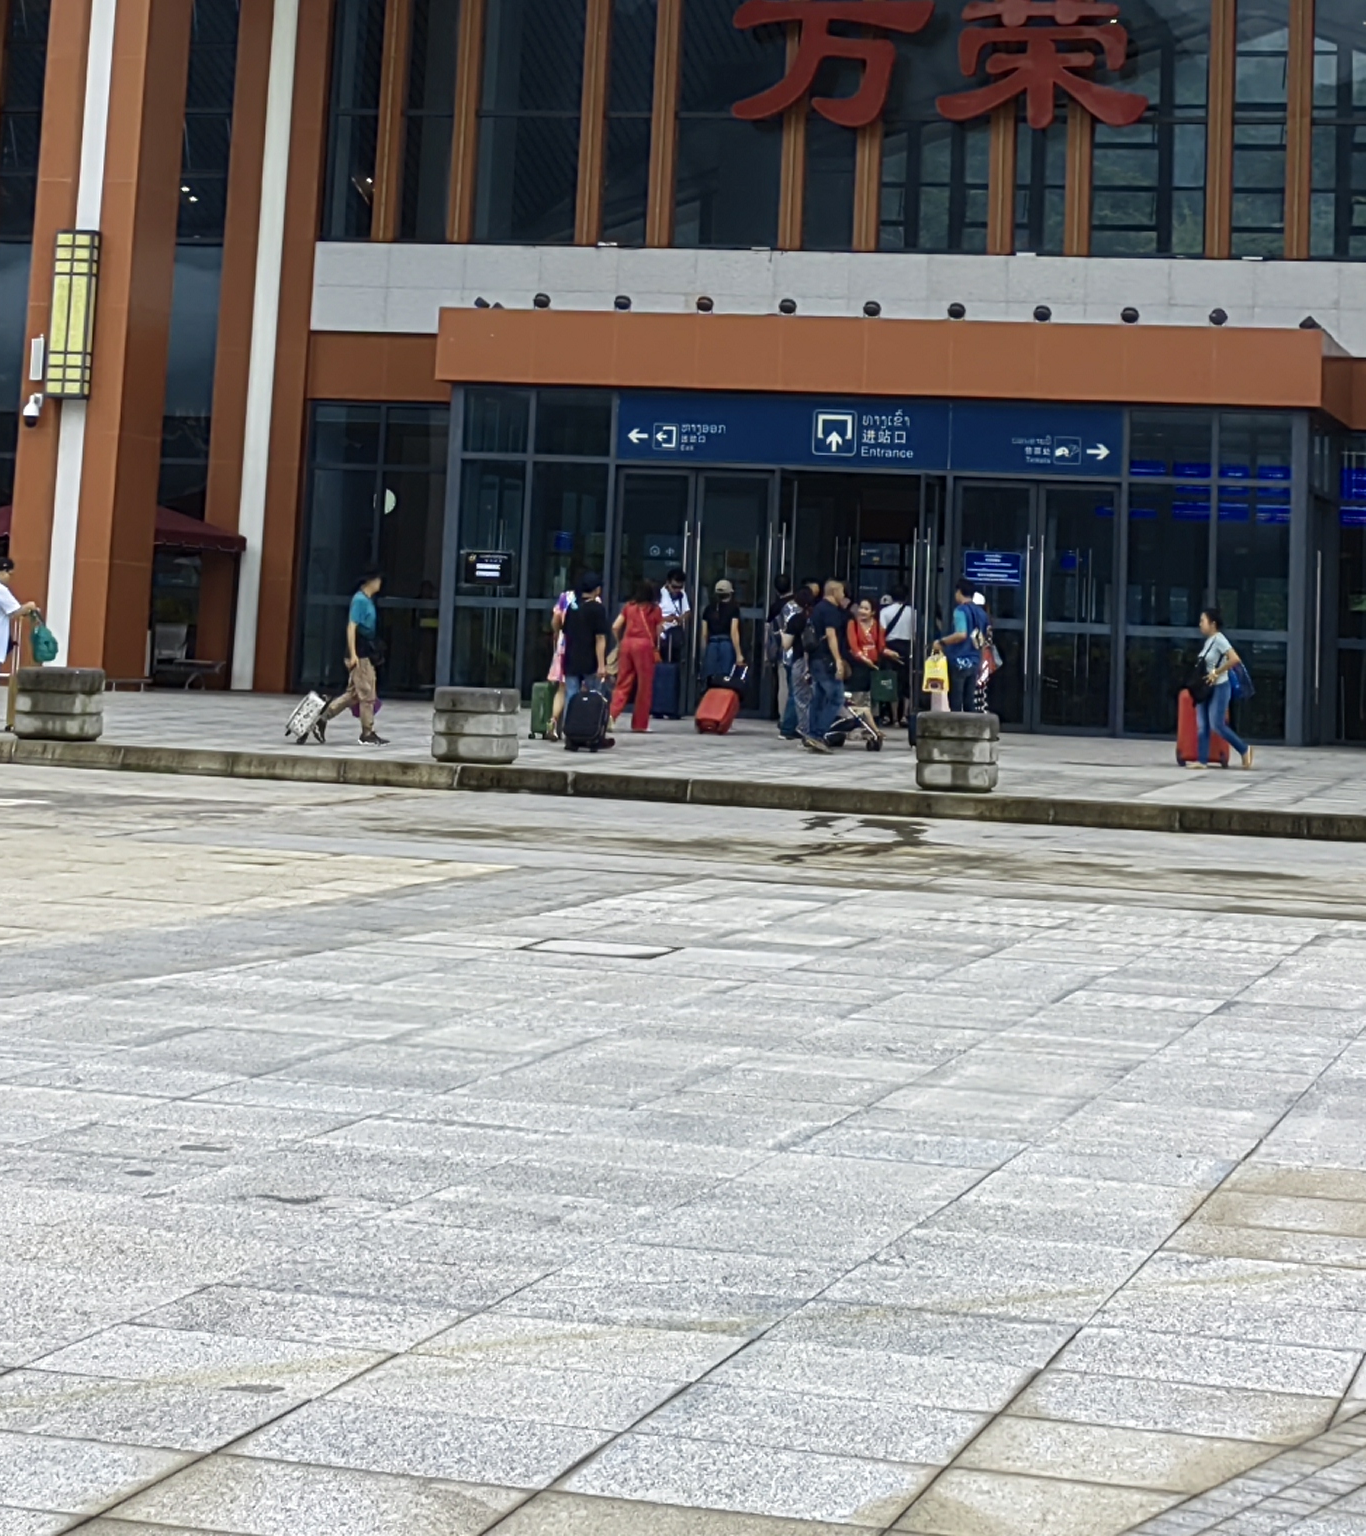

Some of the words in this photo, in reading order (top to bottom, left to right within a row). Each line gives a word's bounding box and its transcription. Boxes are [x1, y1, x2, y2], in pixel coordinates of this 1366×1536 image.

[862, 430, 906, 444] 进站口
[861, 446, 914, 458] Entrance
